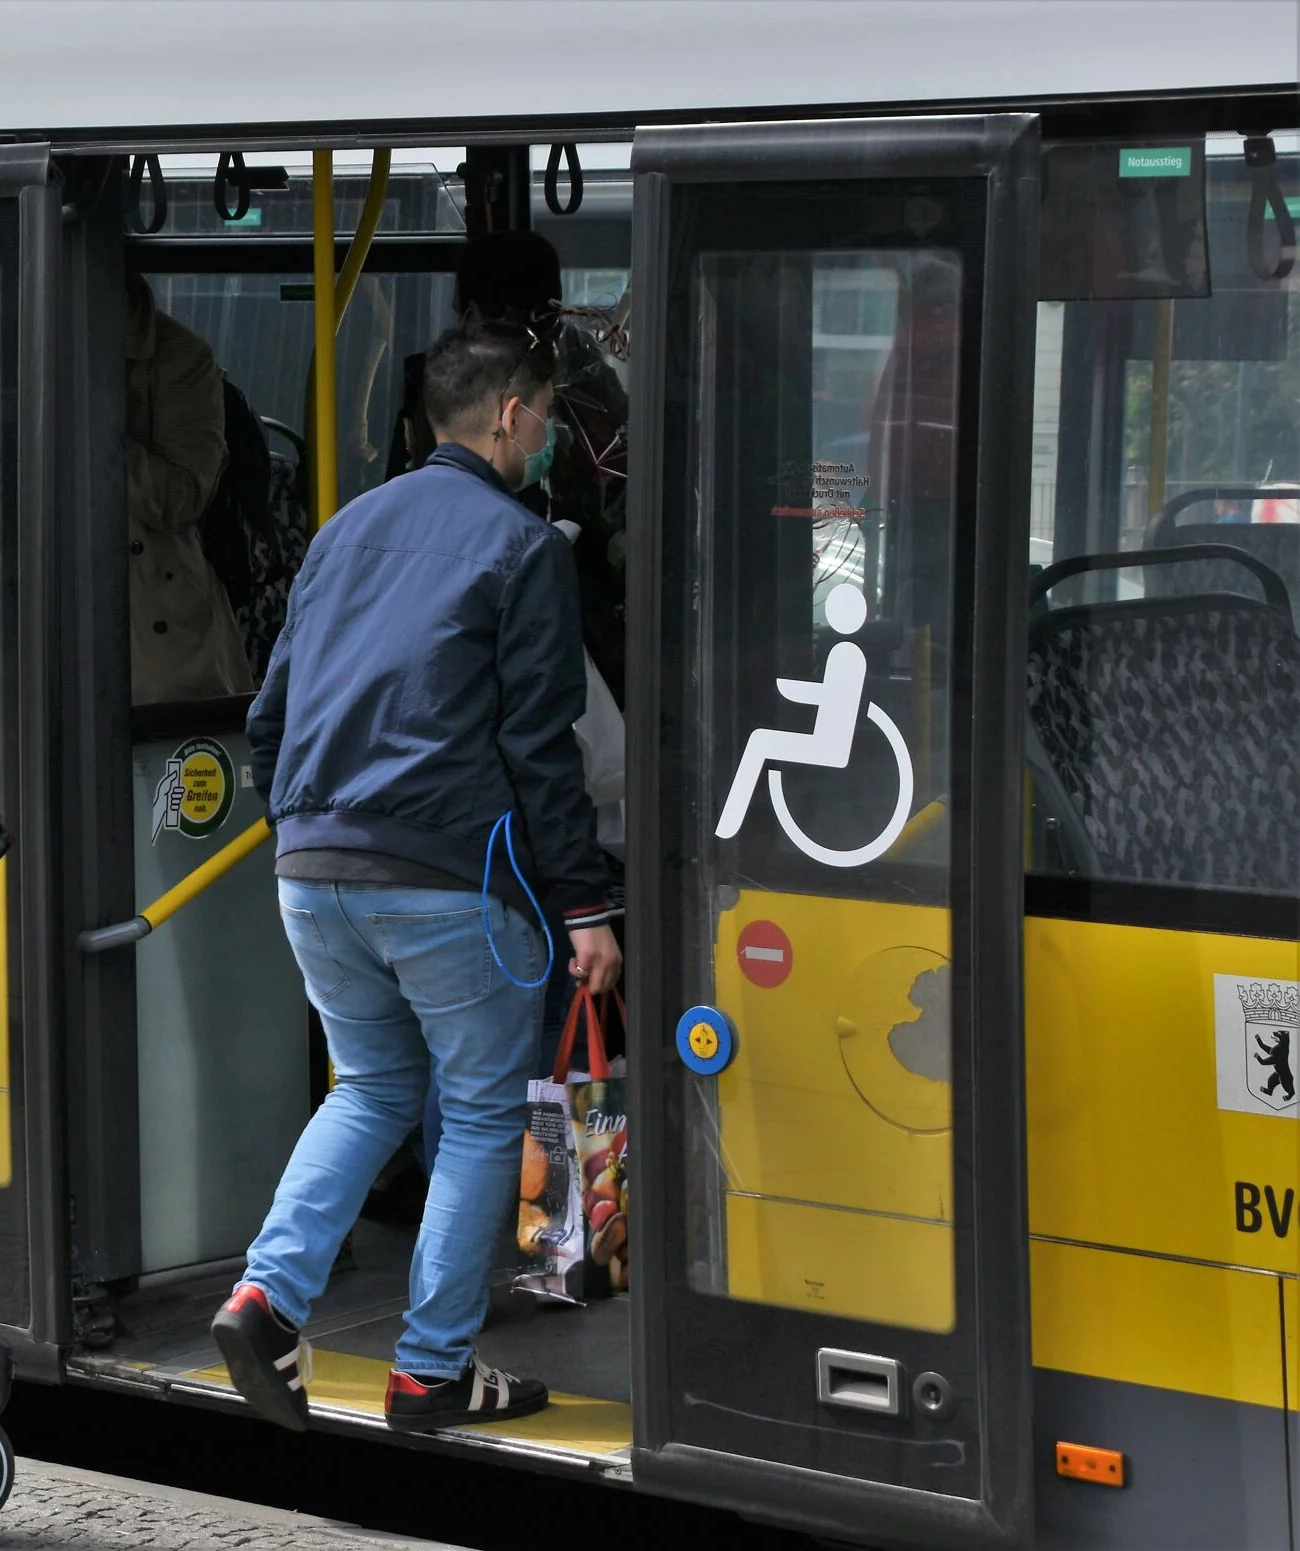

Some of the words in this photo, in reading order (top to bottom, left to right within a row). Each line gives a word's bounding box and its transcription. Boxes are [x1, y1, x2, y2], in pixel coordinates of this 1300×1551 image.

[1127, 155, 1183, 169] Notausstieg
[184, 768, 216, 777] Sicherheit
[186, 789, 219, 802] Greifen
[1234, 1180, 1300, 1239] BV
